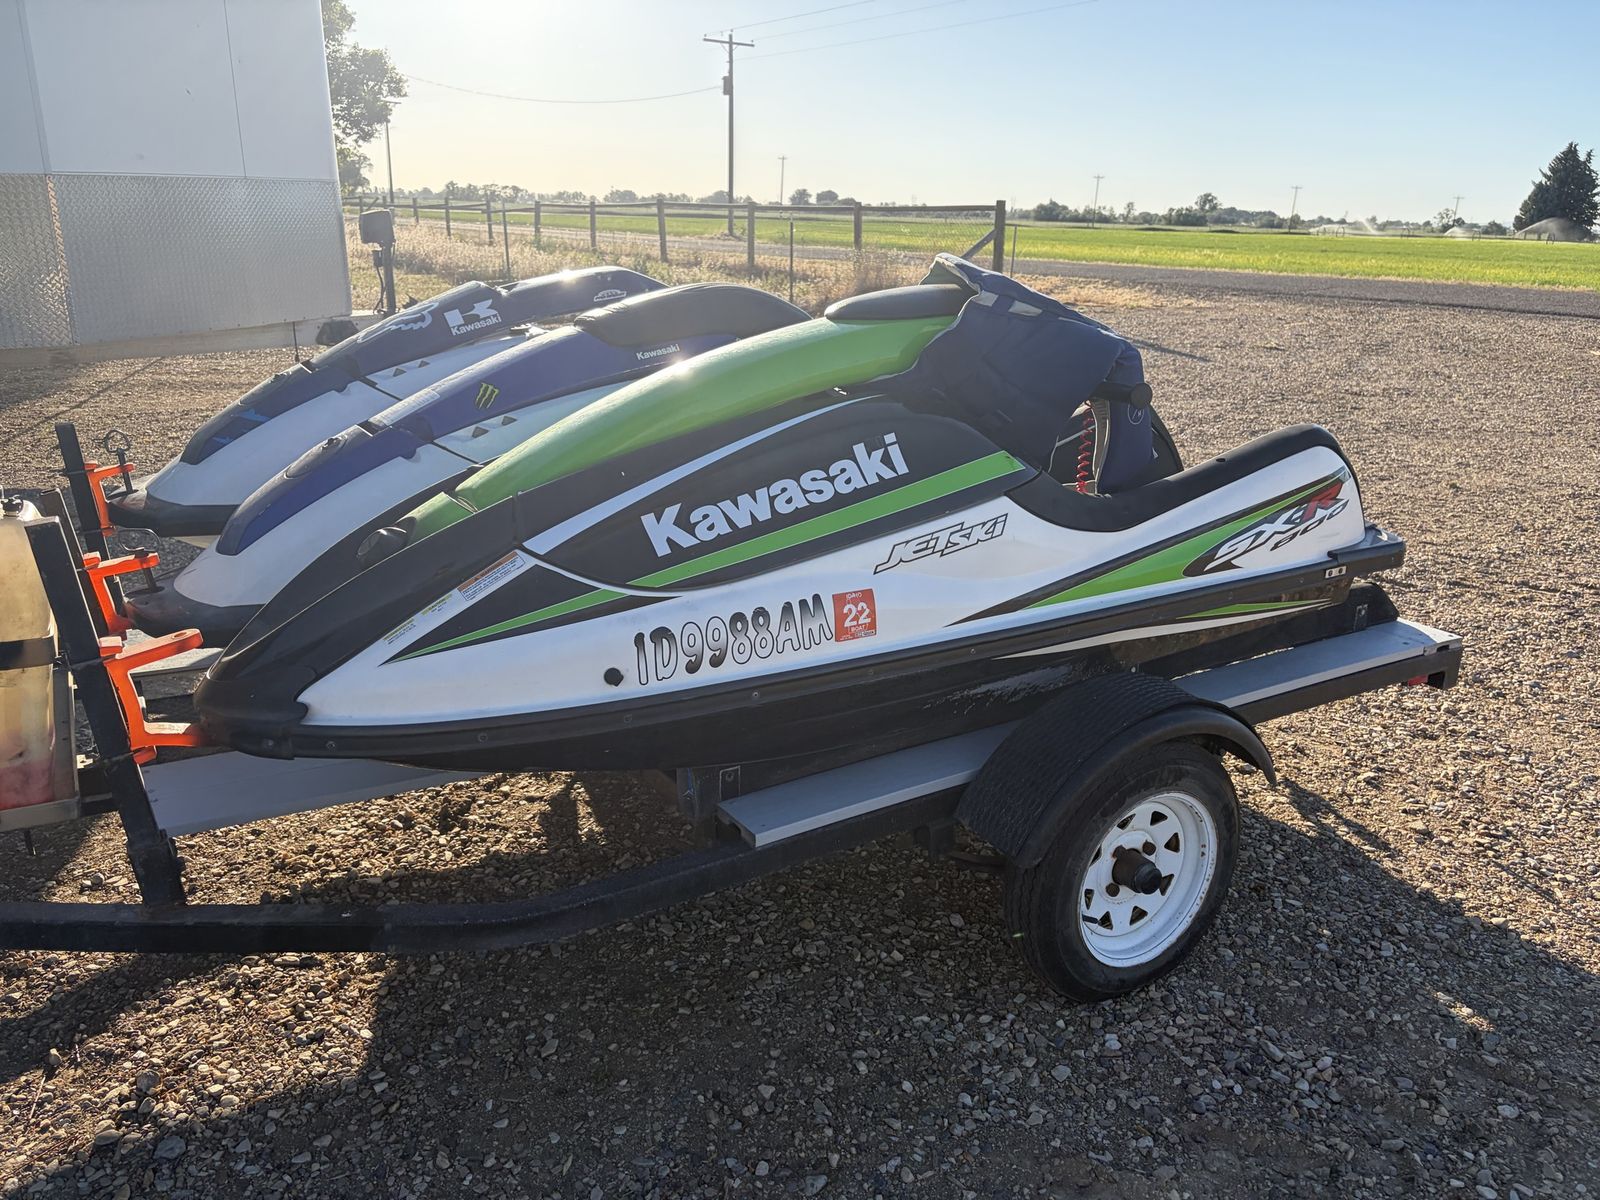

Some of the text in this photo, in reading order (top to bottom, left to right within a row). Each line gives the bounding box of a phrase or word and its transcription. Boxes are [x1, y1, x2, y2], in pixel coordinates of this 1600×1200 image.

[450, 312, 502, 336] Kawasaki
[635, 343, 681, 361] Kawasaki
[640, 432, 909, 557] Kawasaki
[843, 602, 871, 627] 22
[633, 593, 833, 686] ID9988AM
